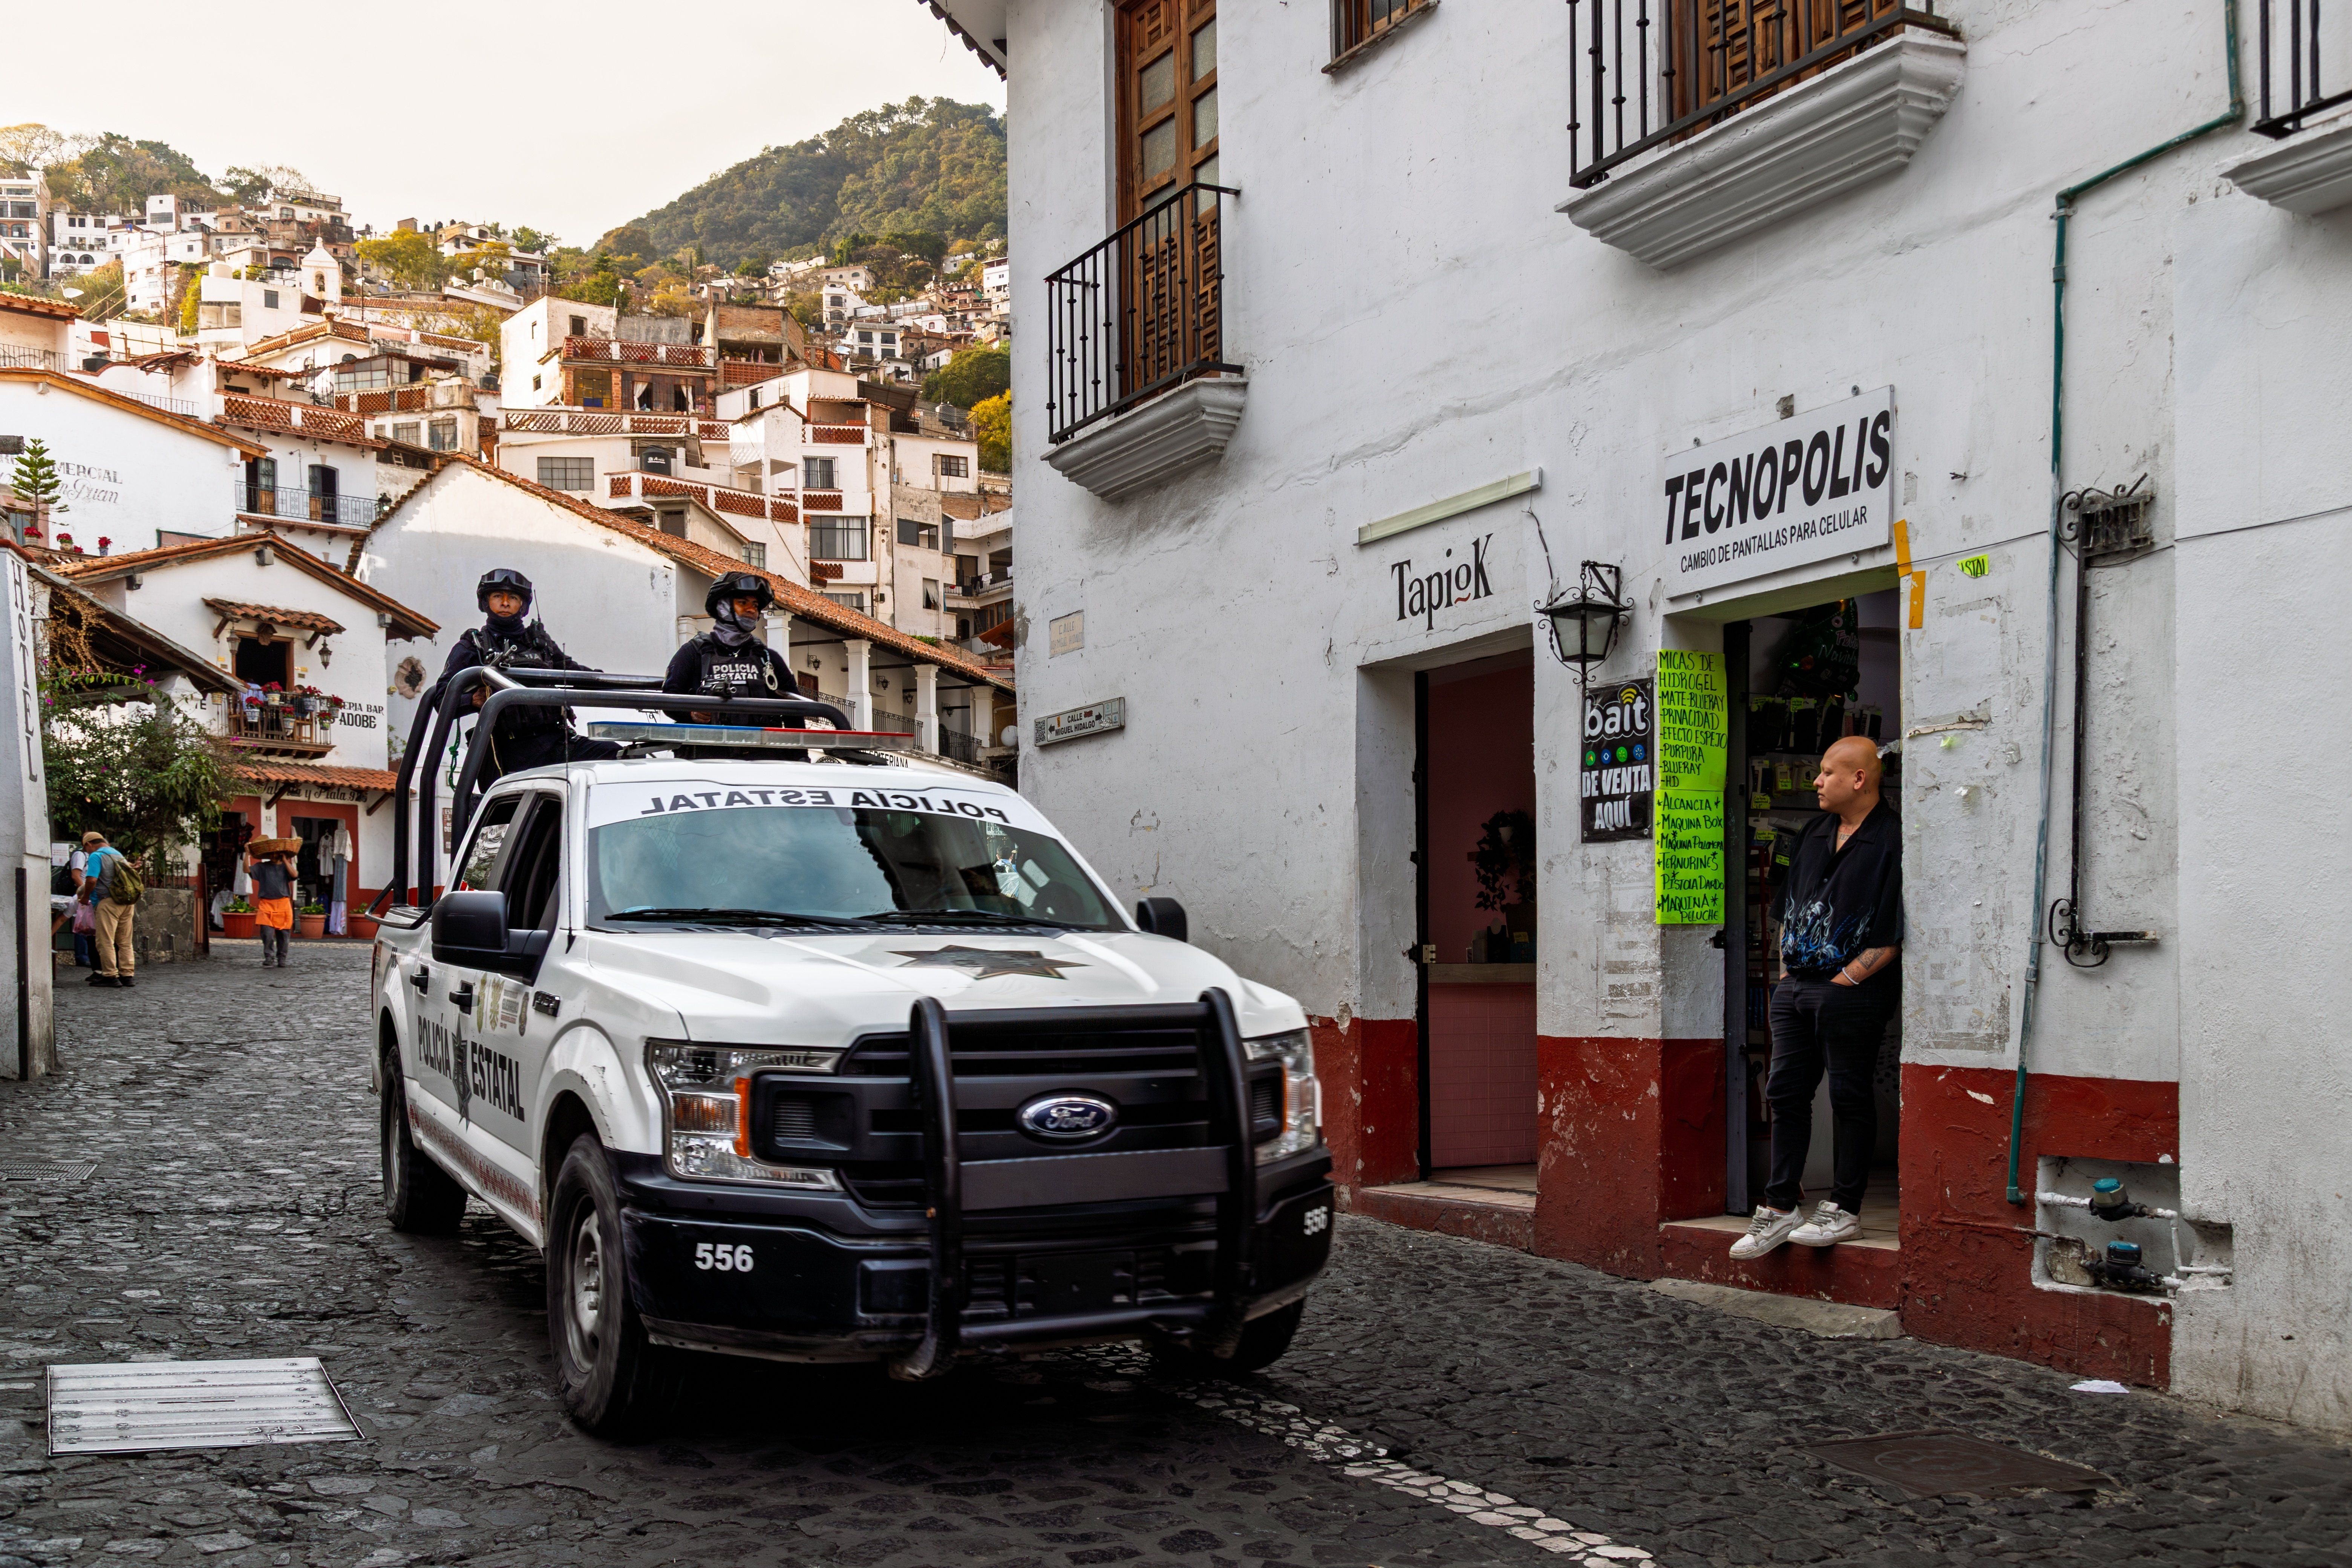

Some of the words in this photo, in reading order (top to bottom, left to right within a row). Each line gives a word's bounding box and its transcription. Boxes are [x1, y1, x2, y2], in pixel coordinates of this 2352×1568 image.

[49, 460, 122, 484] MERCIAL
[1665, 410, 1890, 545] TECNOPOLIS
[1681, 548, 1715, 573] CAMBIO
[1718, 544, 1730, 563] DE
[1733, 530, 1787, 560] PANTALLAS
[1790, 519, 1817, 544] PARA
[1819, 505, 1867, 536] CELULAR
[11, 560, 37, 783] HOTEL
[1659, 651, 1695, 670] MICAS
[1699, 654, 1715, 672] DE
[1659, 672, 1717, 693] HIDROGEL
[366, 704, 384, 716] BAR
[1067, 713, 1083, 723] CALLE
[1584, 696, 1646, 737] bait
[1055, 726, 1073, 737] MIGUEL
[1074, 720, 1095, 732] HIDALGO
[1695, 730, 1728, 749] ESPEJO
[1582, 770, 1599, 798] DE
[1602, 764, 1651, 796] VENTA
[1594, 795, 1631, 831] AQUÍ
[1681, 909, 1719, 923] PELUCHE
[418, 1013, 452, 1080] POLICÍA
[470, 1041, 525, 1122] ESTATAL
[1045, 1107, 1097, 1129] Ford
[1303, 1206, 1328, 1235] 556
[695, 1243, 754, 1272] 556
